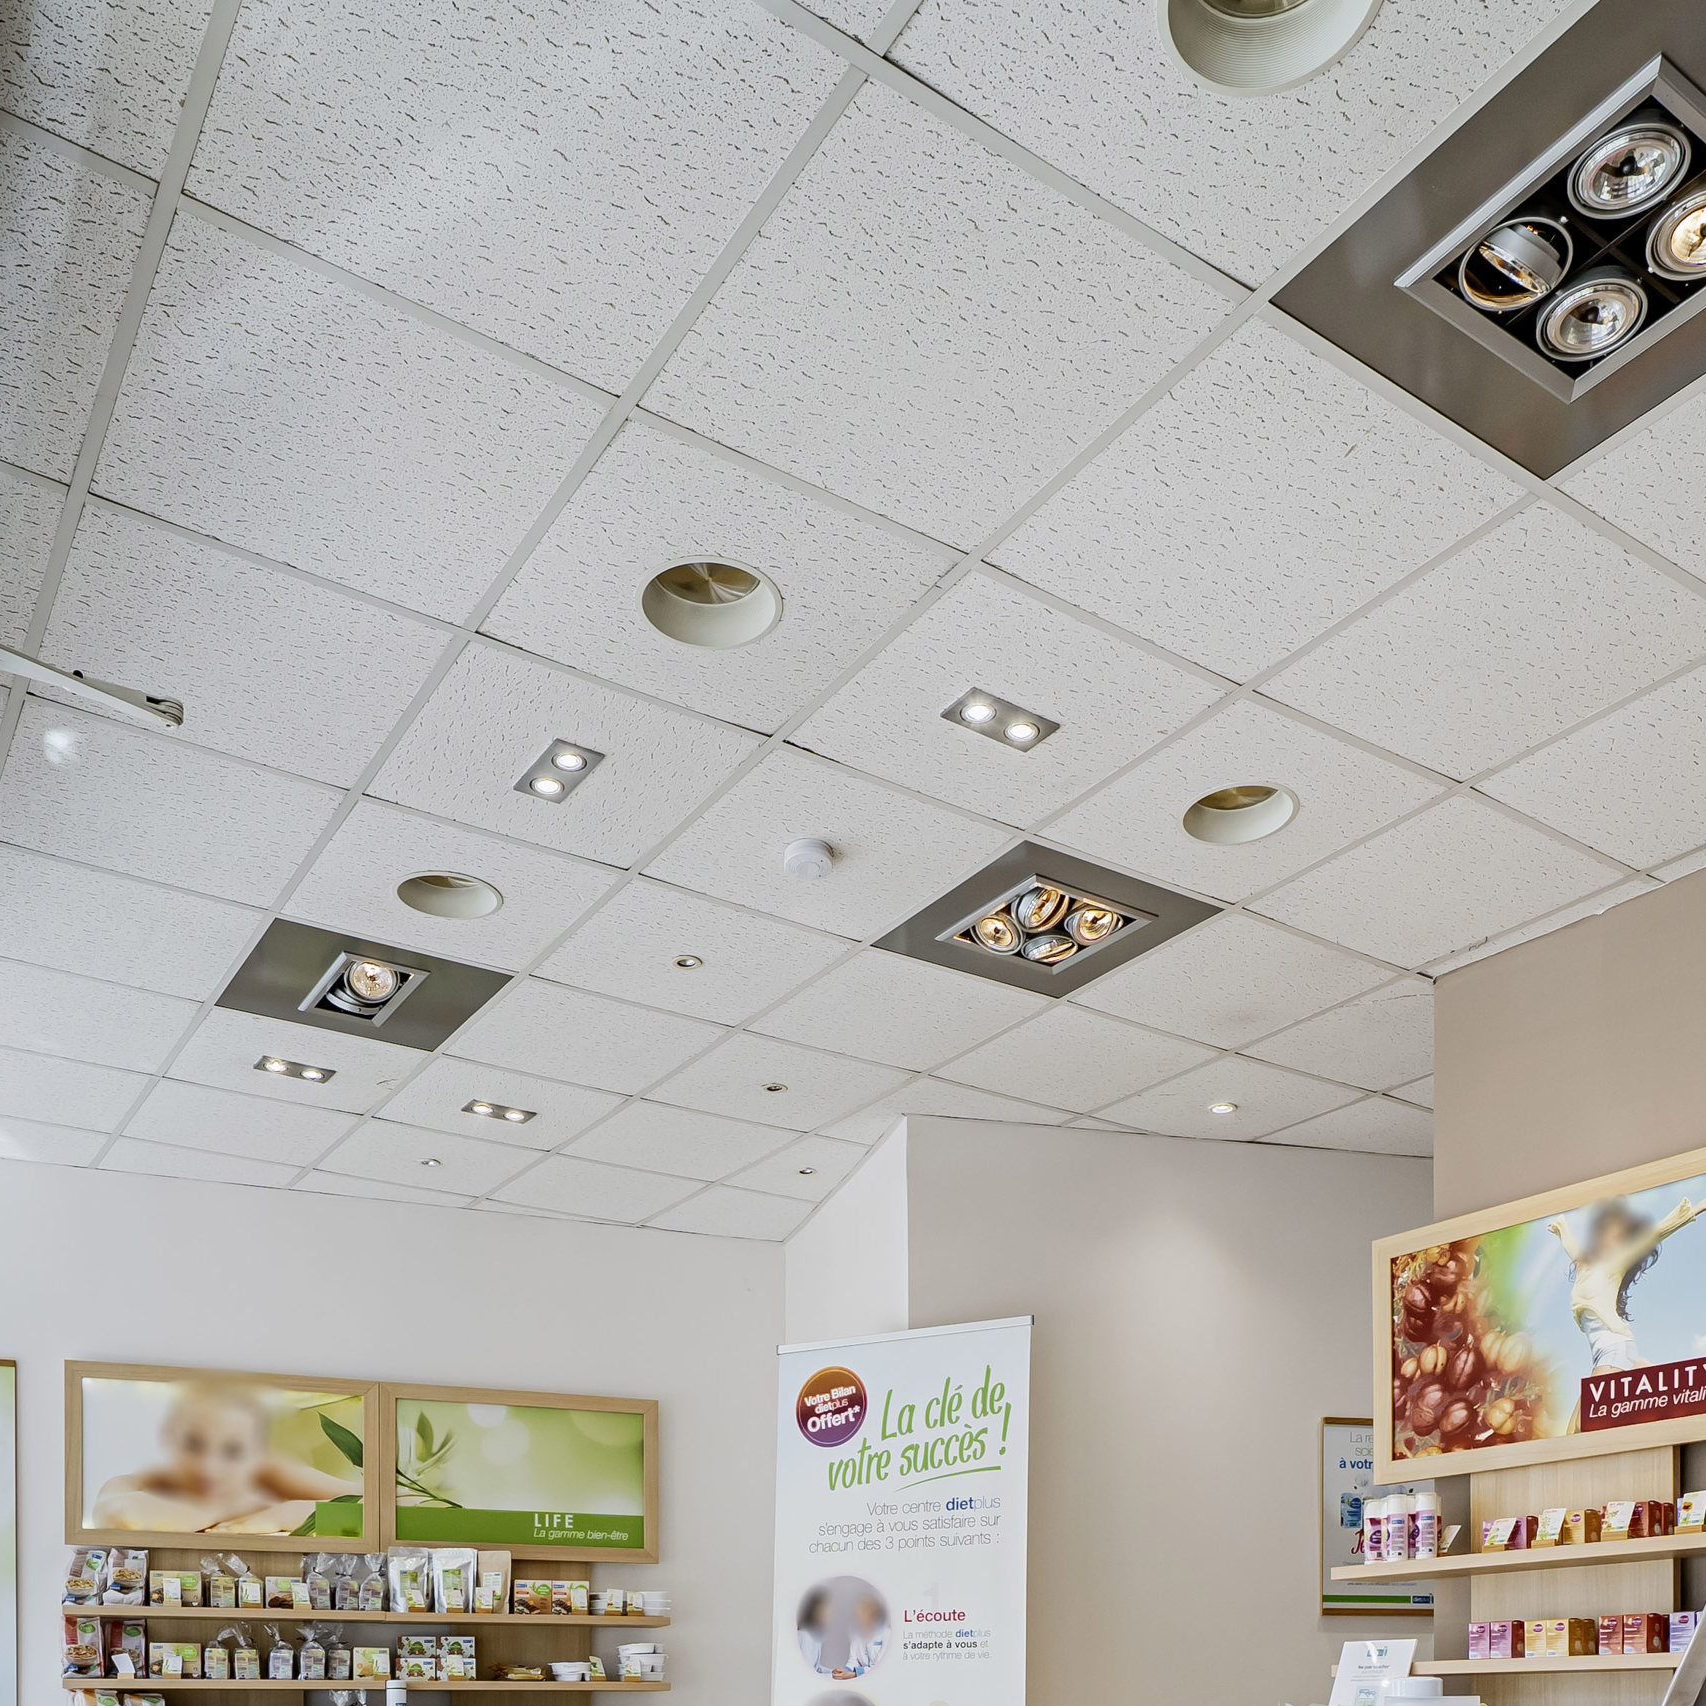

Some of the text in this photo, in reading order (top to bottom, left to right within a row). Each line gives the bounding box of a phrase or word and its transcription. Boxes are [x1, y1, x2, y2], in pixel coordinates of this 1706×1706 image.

[804, 1385, 857, 1407] Votre Bilan
[881, 1364, 1005, 1442] La clé de
[814, 1398, 849, 1415] dietplus
[1589, 1404, 1608, 1418] La
[1610, 1394, 1669, 1418] gamme
[1349, 1431, 1364, 1444] La
[828, 1402, 1012, 1492] votre succès !
[1339, 1457, 1347, 1469] à
[866, 1496, 1001, 1516] Votre centre dietplus
[534, 1513, 574, 1529] LIFE
[818, 1514, 1001, 1538] s'engage à vous satisfaire sur
[533, 1528, 629, 1541] La gamme bien-être
[809, 1539, 853, 1553] chacun
[857, 1537, 881, 1551] des
[885, 1536, 893, 1550] 3
[898, 1533, 935, 1551] points
[939, 1532, 991, 1547] suivants
[904, 1609, 966, 1622] L'écoute
[955, 1629, 991, 1638] dietplus
[903, 1641, 943, 1650] s'adapte
[946, 1640, 952, 1648] à
[980, 1640, 988, 1648] et
[964, 1651, 975, 1659] de
